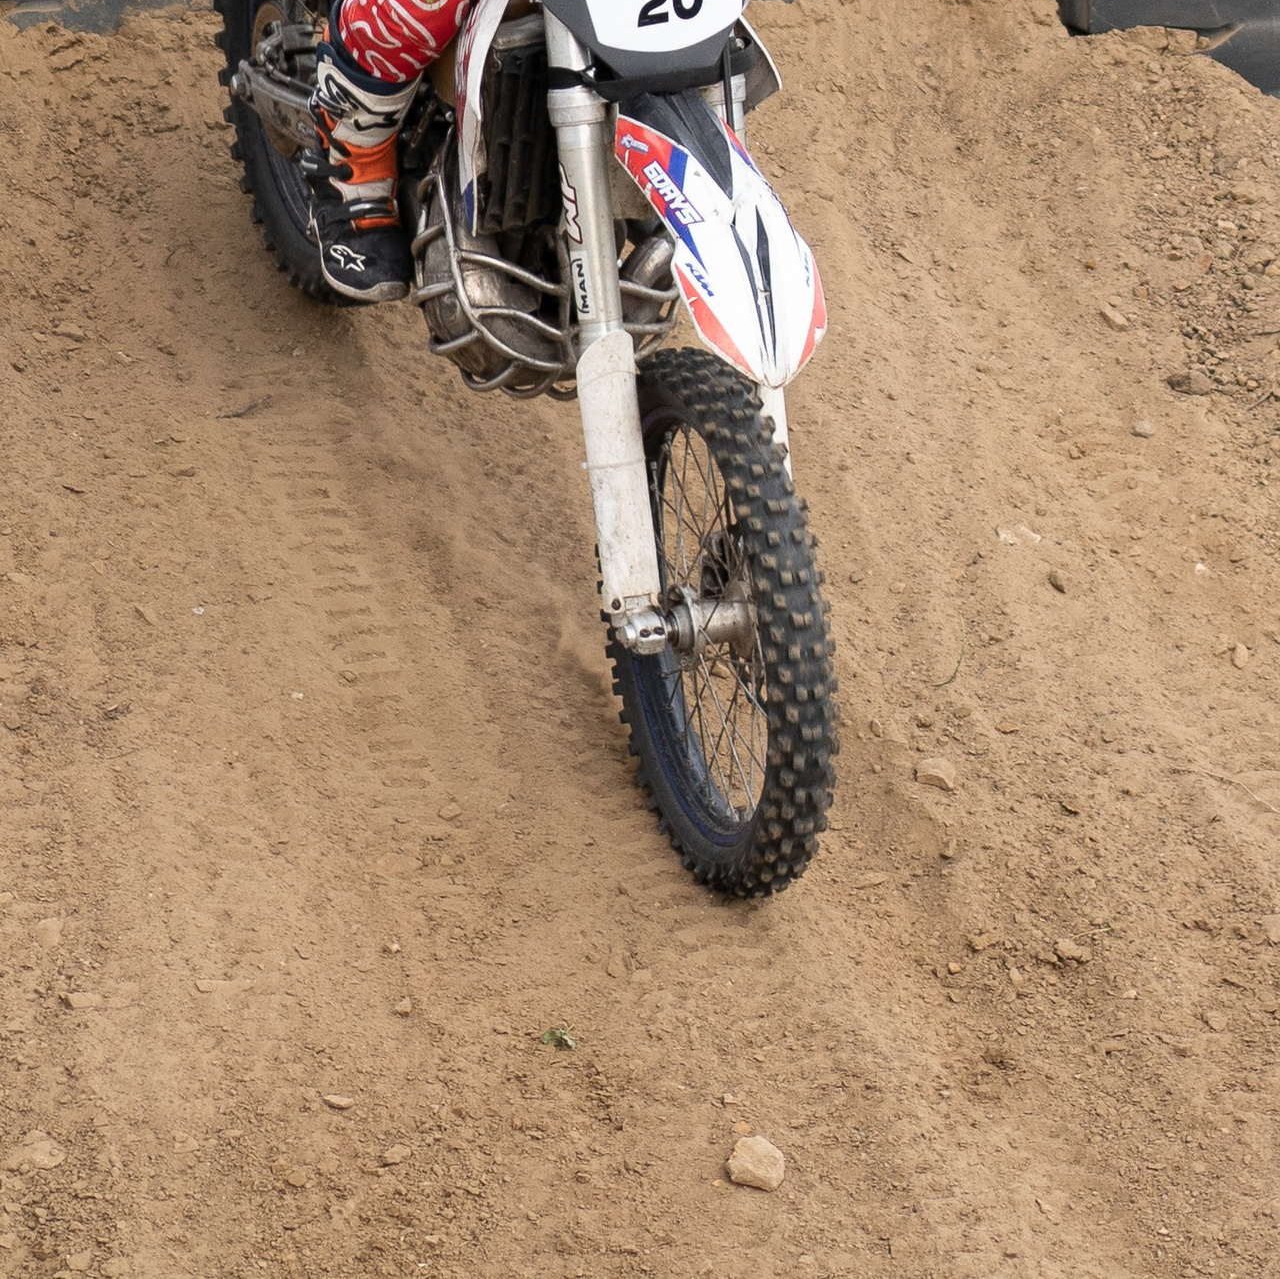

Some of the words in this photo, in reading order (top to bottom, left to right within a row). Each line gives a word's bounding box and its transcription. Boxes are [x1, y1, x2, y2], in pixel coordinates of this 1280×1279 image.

[642, 159, 702, 225] 6DAYS
[577, 263, 590, 311] MAN
[685, 262, 714, 297] KTM
